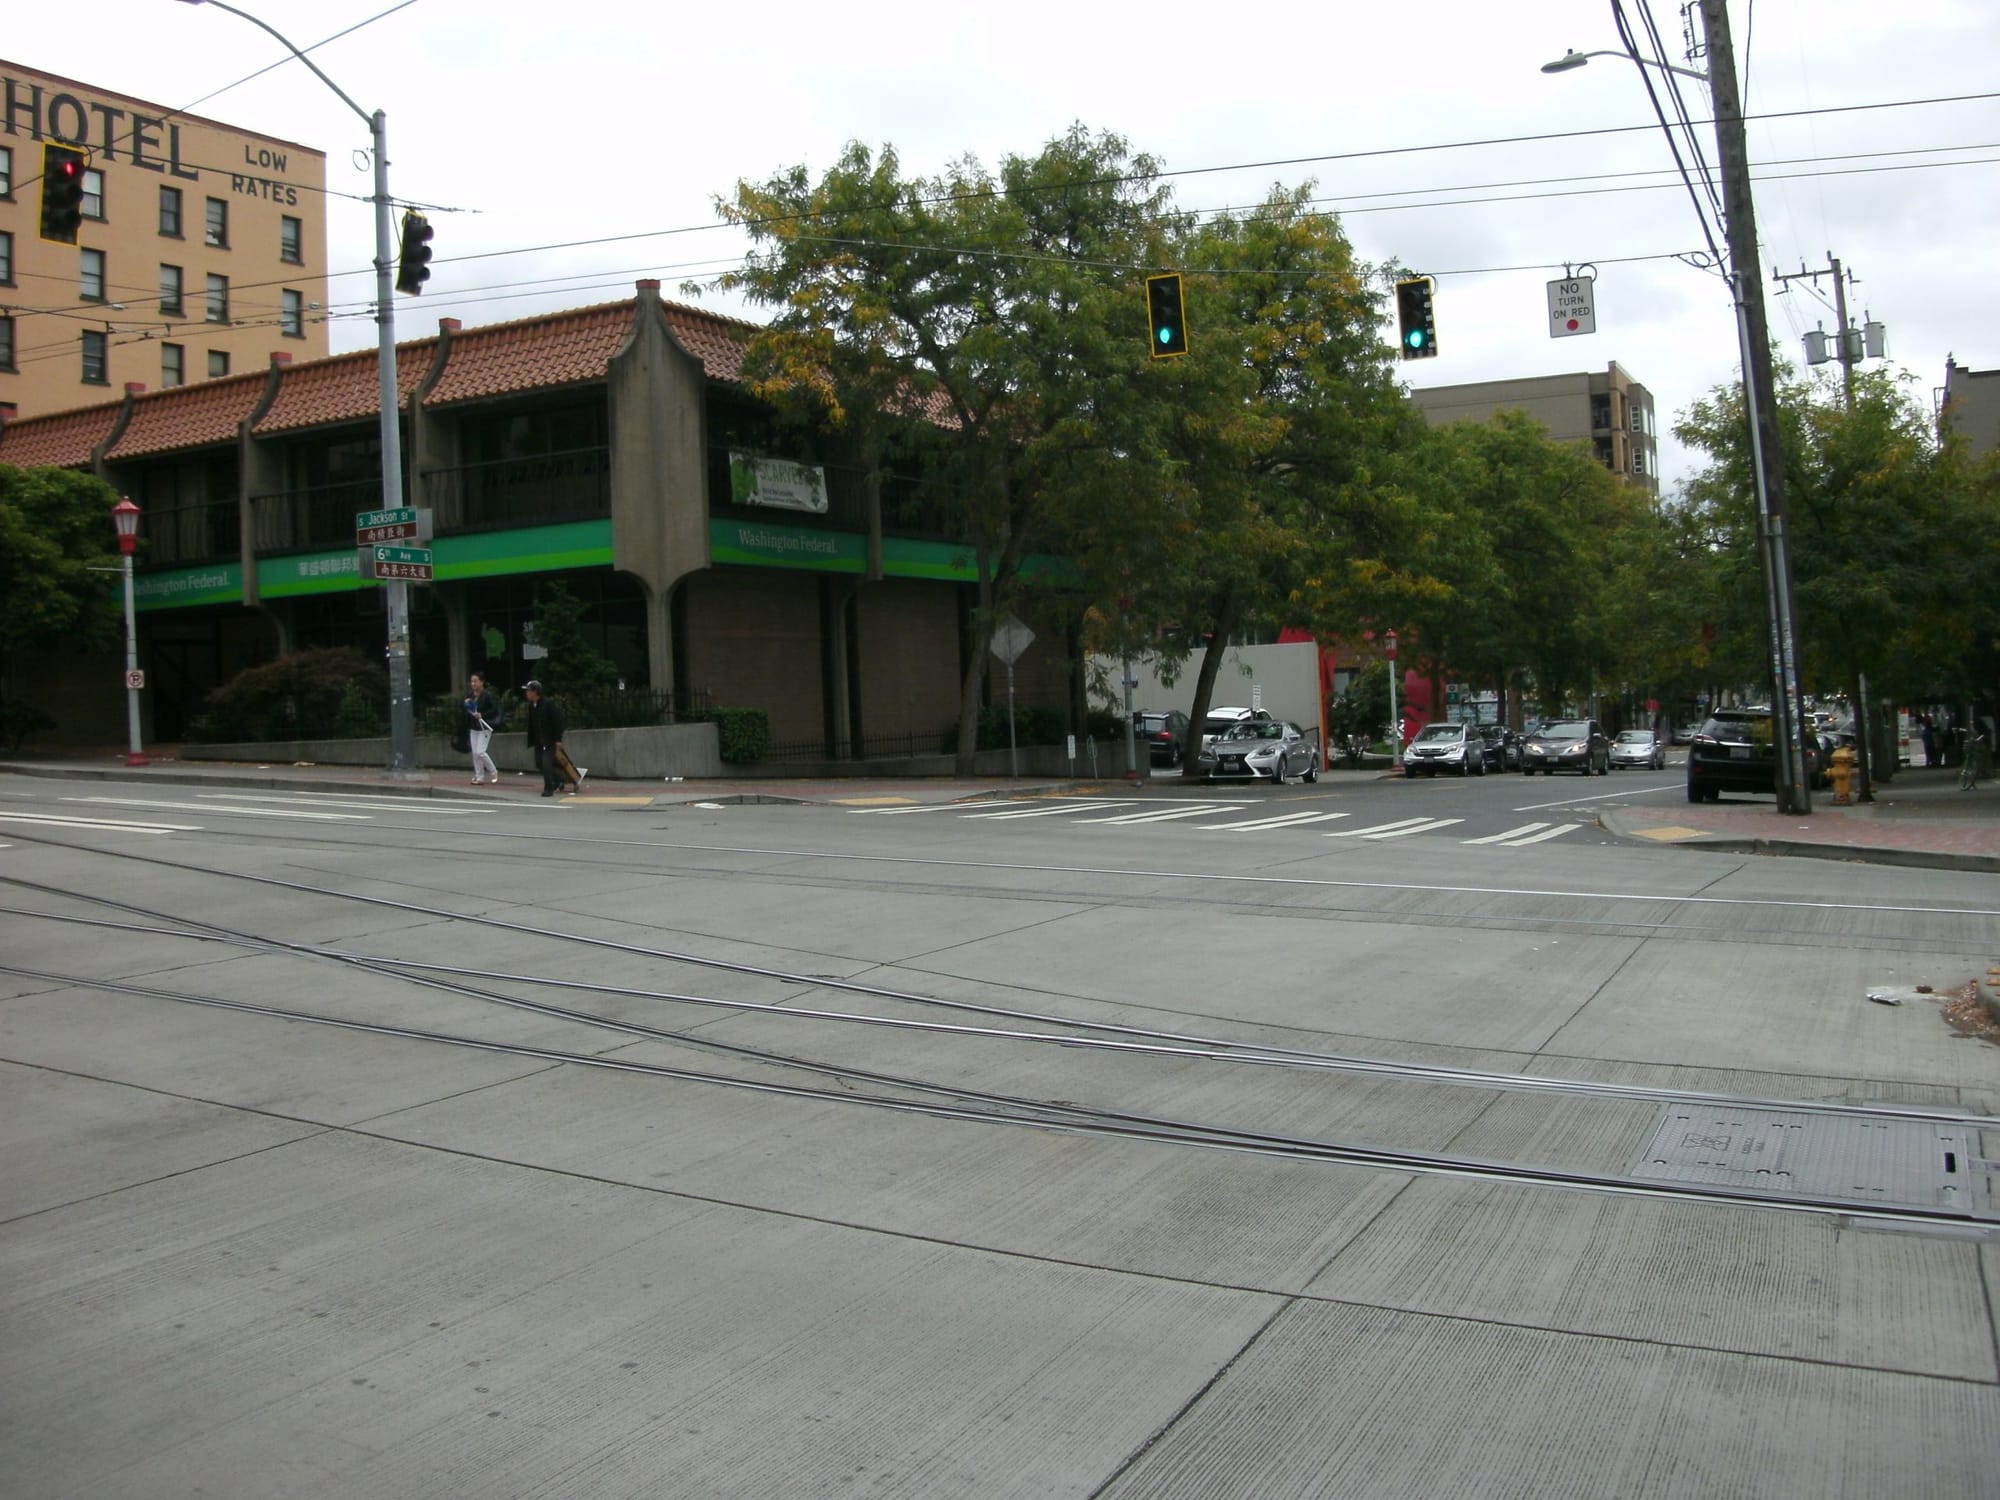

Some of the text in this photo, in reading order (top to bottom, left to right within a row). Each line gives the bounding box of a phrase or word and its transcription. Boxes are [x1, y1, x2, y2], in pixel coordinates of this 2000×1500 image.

[3, 77, 199, 181] HOTEL
[245, 145, 288, 173] LOW
[232, 174, 298, 206] RATES
[1560, 283, 1579, 295] NO
[1558, 296, 1584, 306] TURN
[1553, 307, 1590, 319] ON RED
[359, 511, 408, 527] S Jackson St
[738, 528, 799, 553] Washington
[400, 551, 411, 561] Ave
[424, 553, 430, 562] S
[134, 577, 186, 596] ashington
